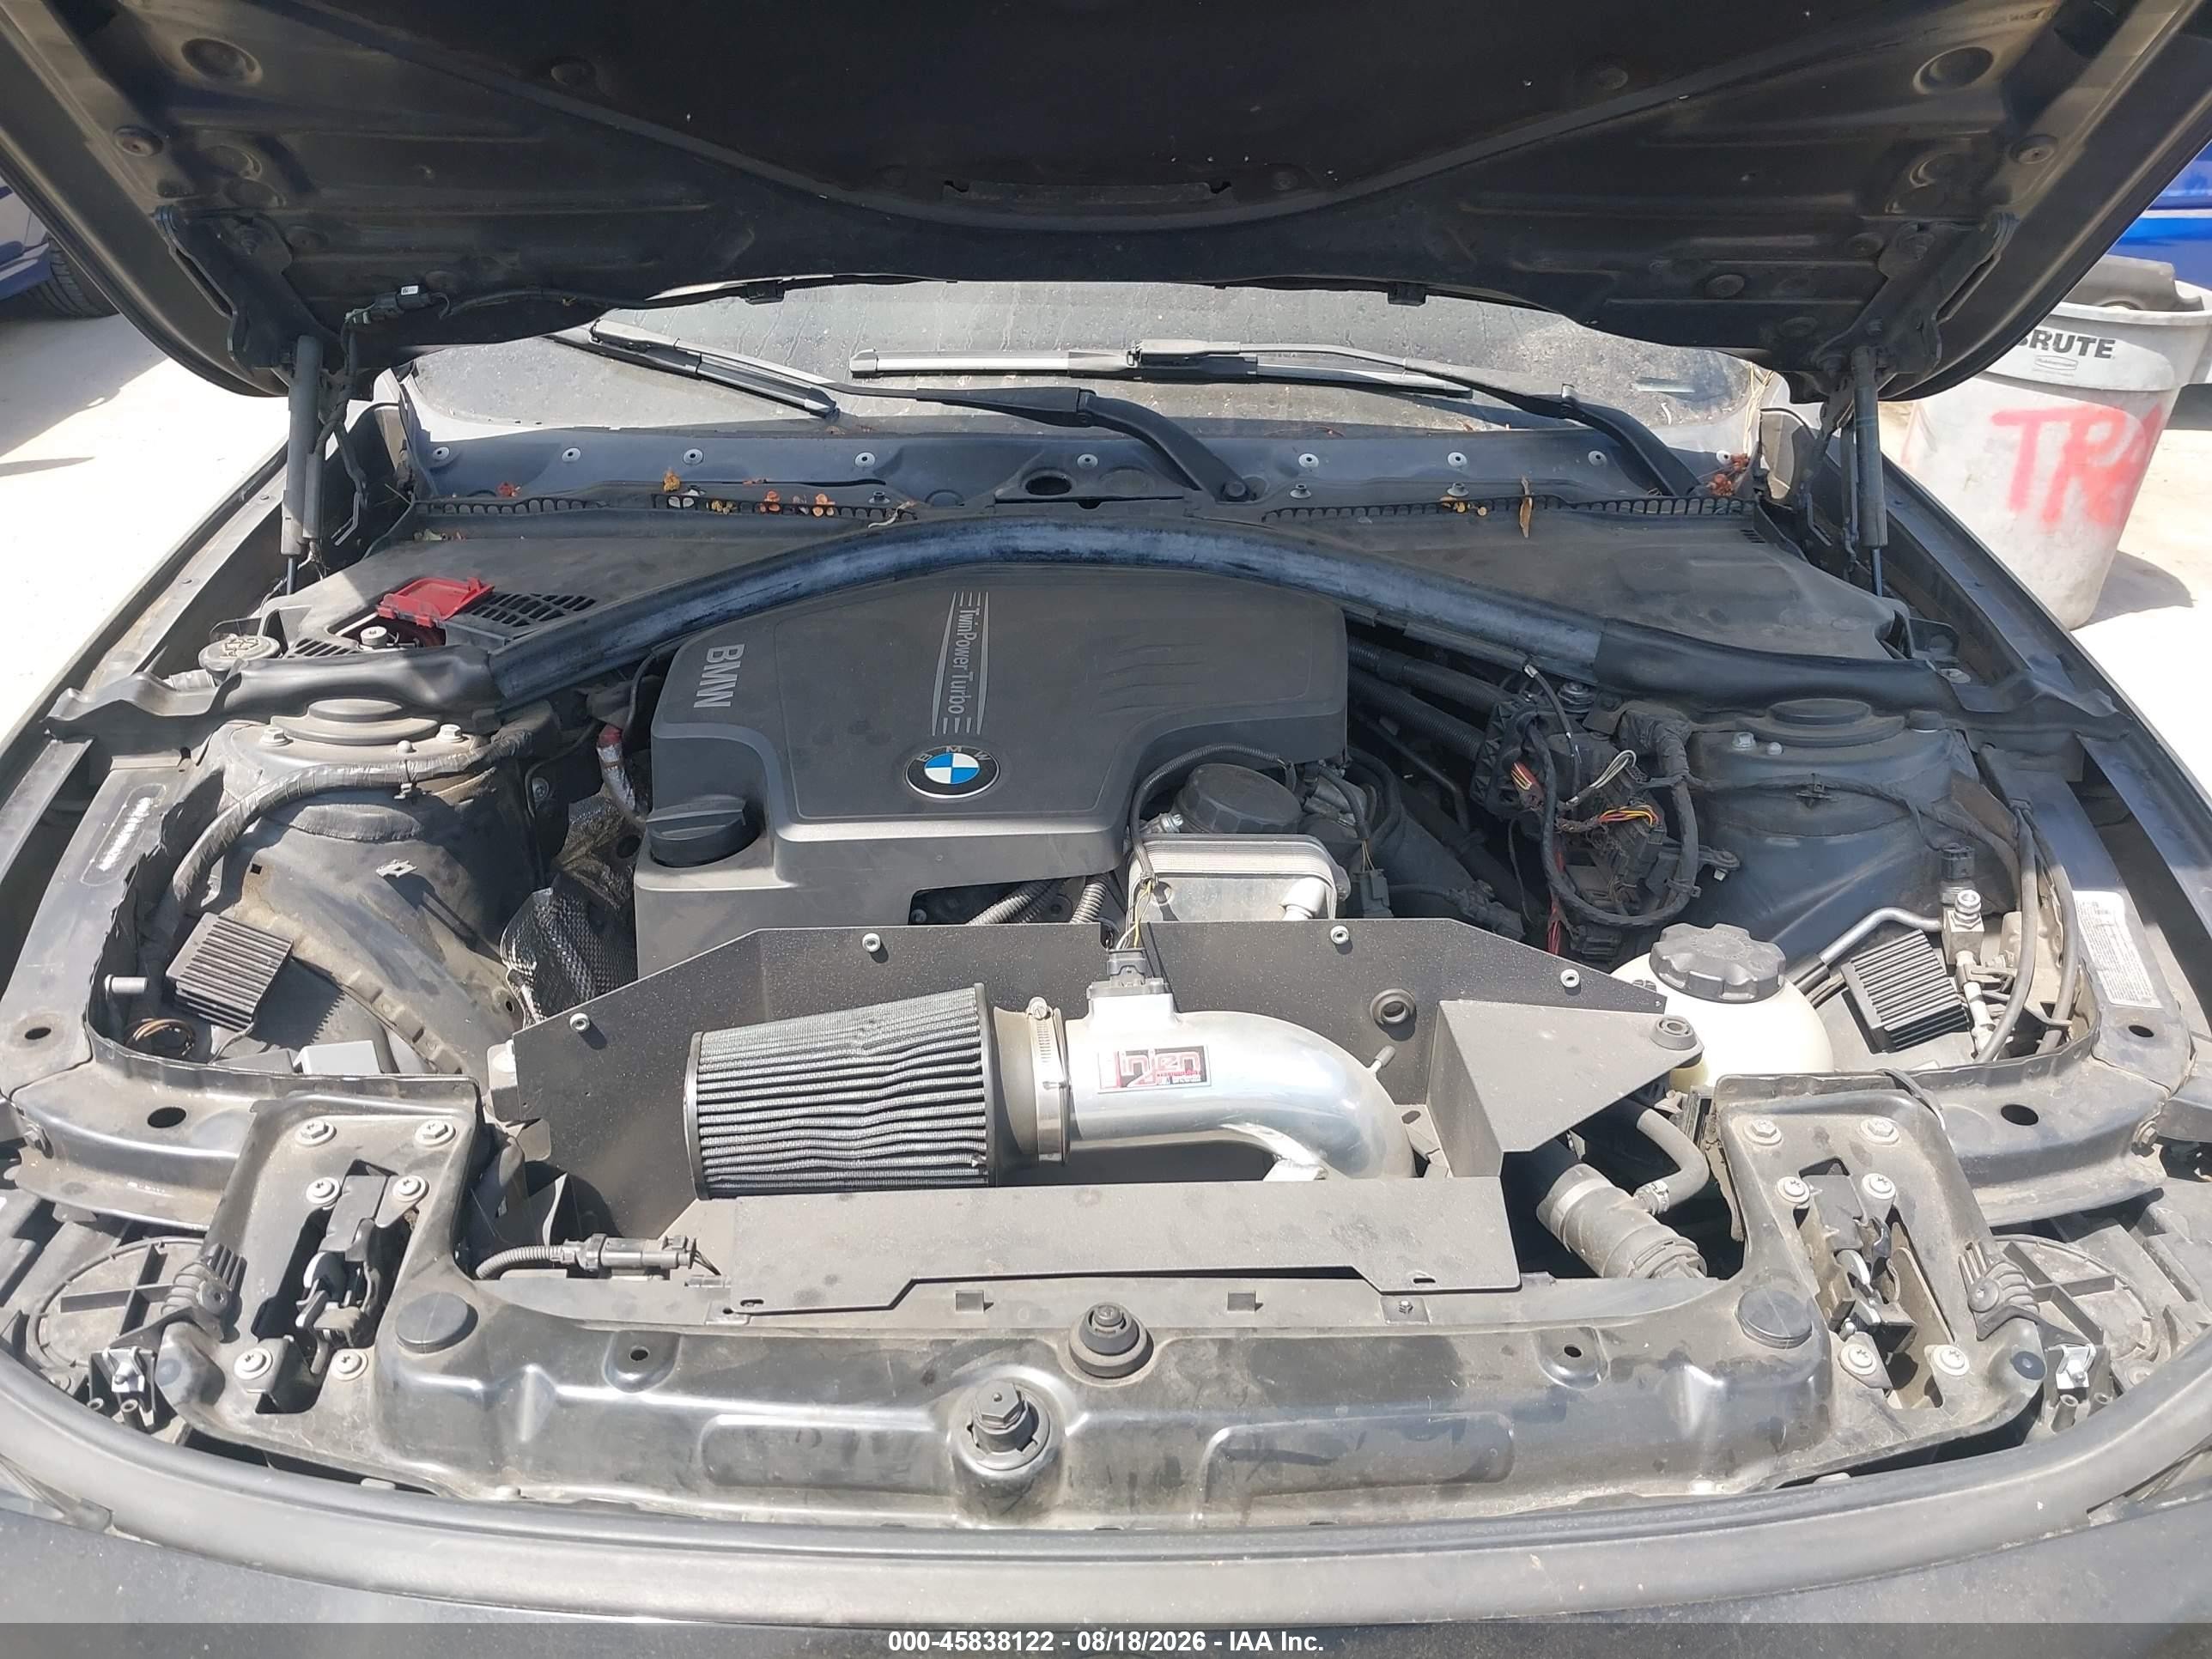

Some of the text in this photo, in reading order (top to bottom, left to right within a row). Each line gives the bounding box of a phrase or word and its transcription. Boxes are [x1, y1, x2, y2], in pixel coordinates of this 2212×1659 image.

[693, 643, 745, 708] BMW
[947, 608, 980, 714] TwinPower Turbo
[915, 744, 993, 763] BMW
